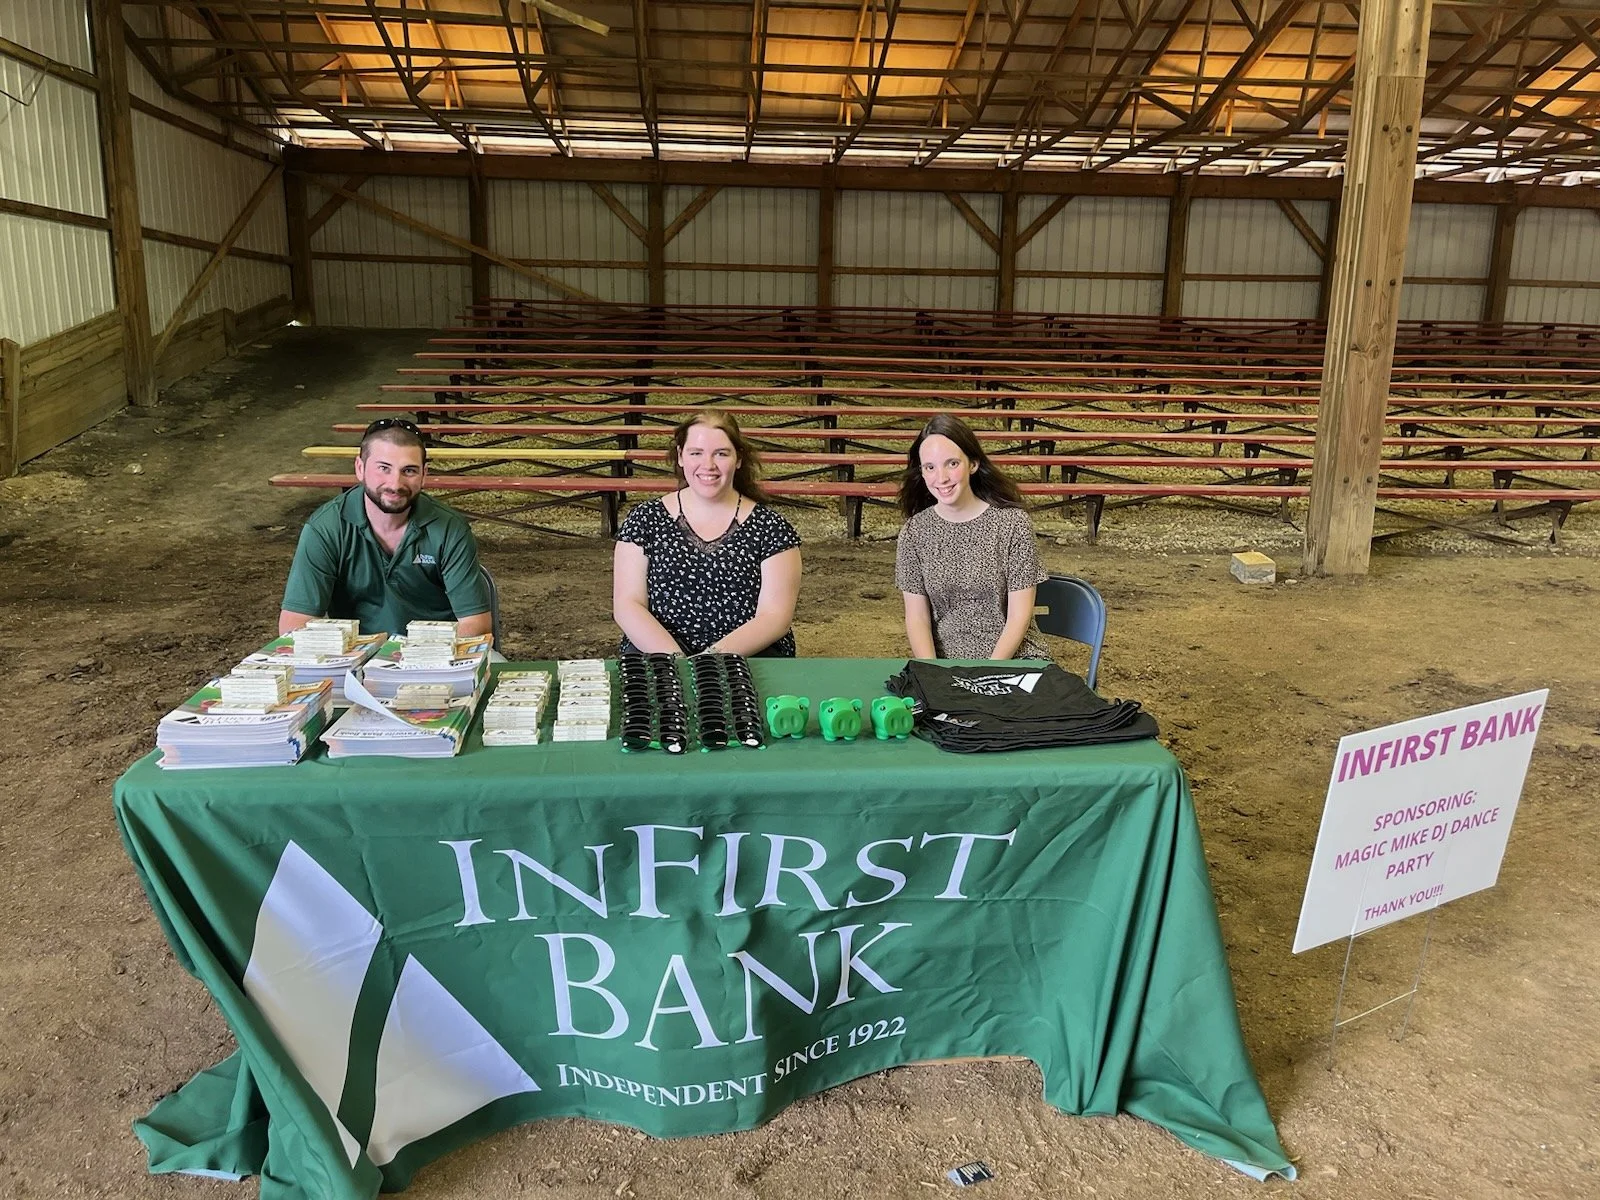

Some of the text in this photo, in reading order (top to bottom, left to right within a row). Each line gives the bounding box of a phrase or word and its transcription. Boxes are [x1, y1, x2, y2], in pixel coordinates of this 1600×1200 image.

[1338, 704, 1543, 783] INFIRST BANK
[1334, 807, 1500, 870] MAGIC MIKE DJ DANCE
[1373, 790, 1478, 832] SPONSORING:
[438, 823, 1018, 928] INFIRST
[1385, 851, 1435, 880] PARTY
[1364, 883, 1444, 921] THANK YOU!!!
[534, 921, 913, 1053] BANK
[556, 1015, 908, 1109] INDEPENDENT SINCE 1922
